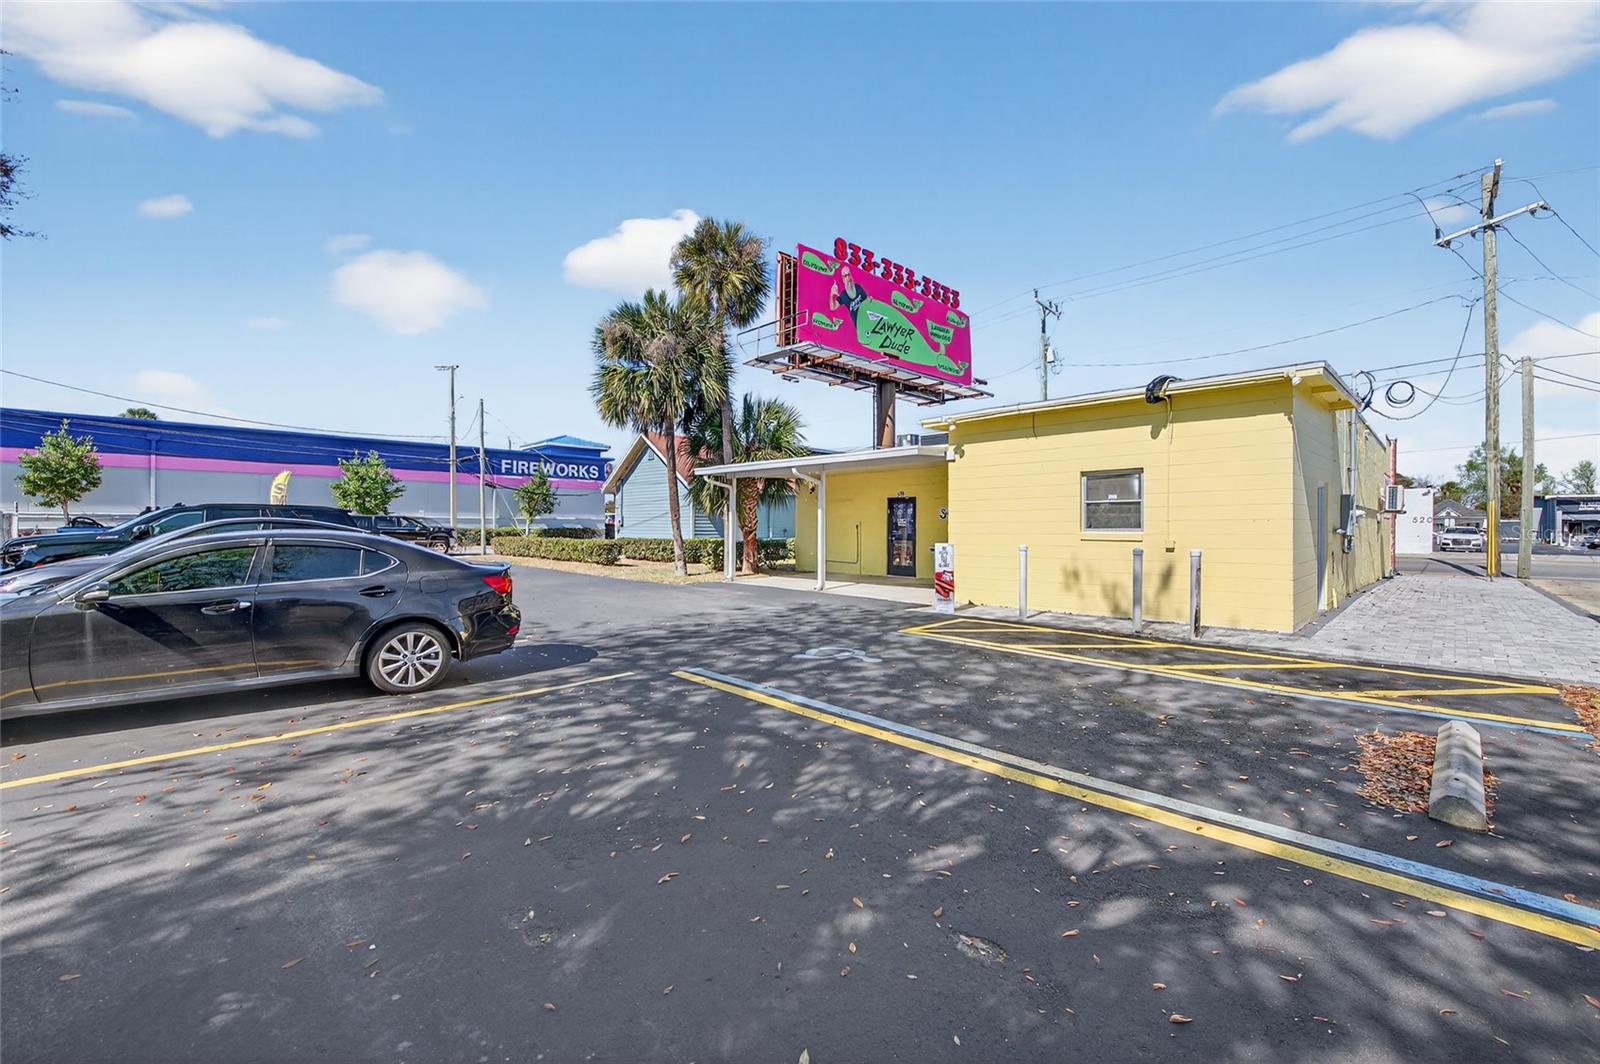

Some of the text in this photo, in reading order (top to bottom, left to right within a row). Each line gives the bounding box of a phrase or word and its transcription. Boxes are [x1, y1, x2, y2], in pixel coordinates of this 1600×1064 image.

[834, 237, 960, 309] 833-333-3333
[879, 335, 911, 354] Dude
[501, 460, 599, 479] FIREWORKS
[1412, 516, 1433, 524] 520
